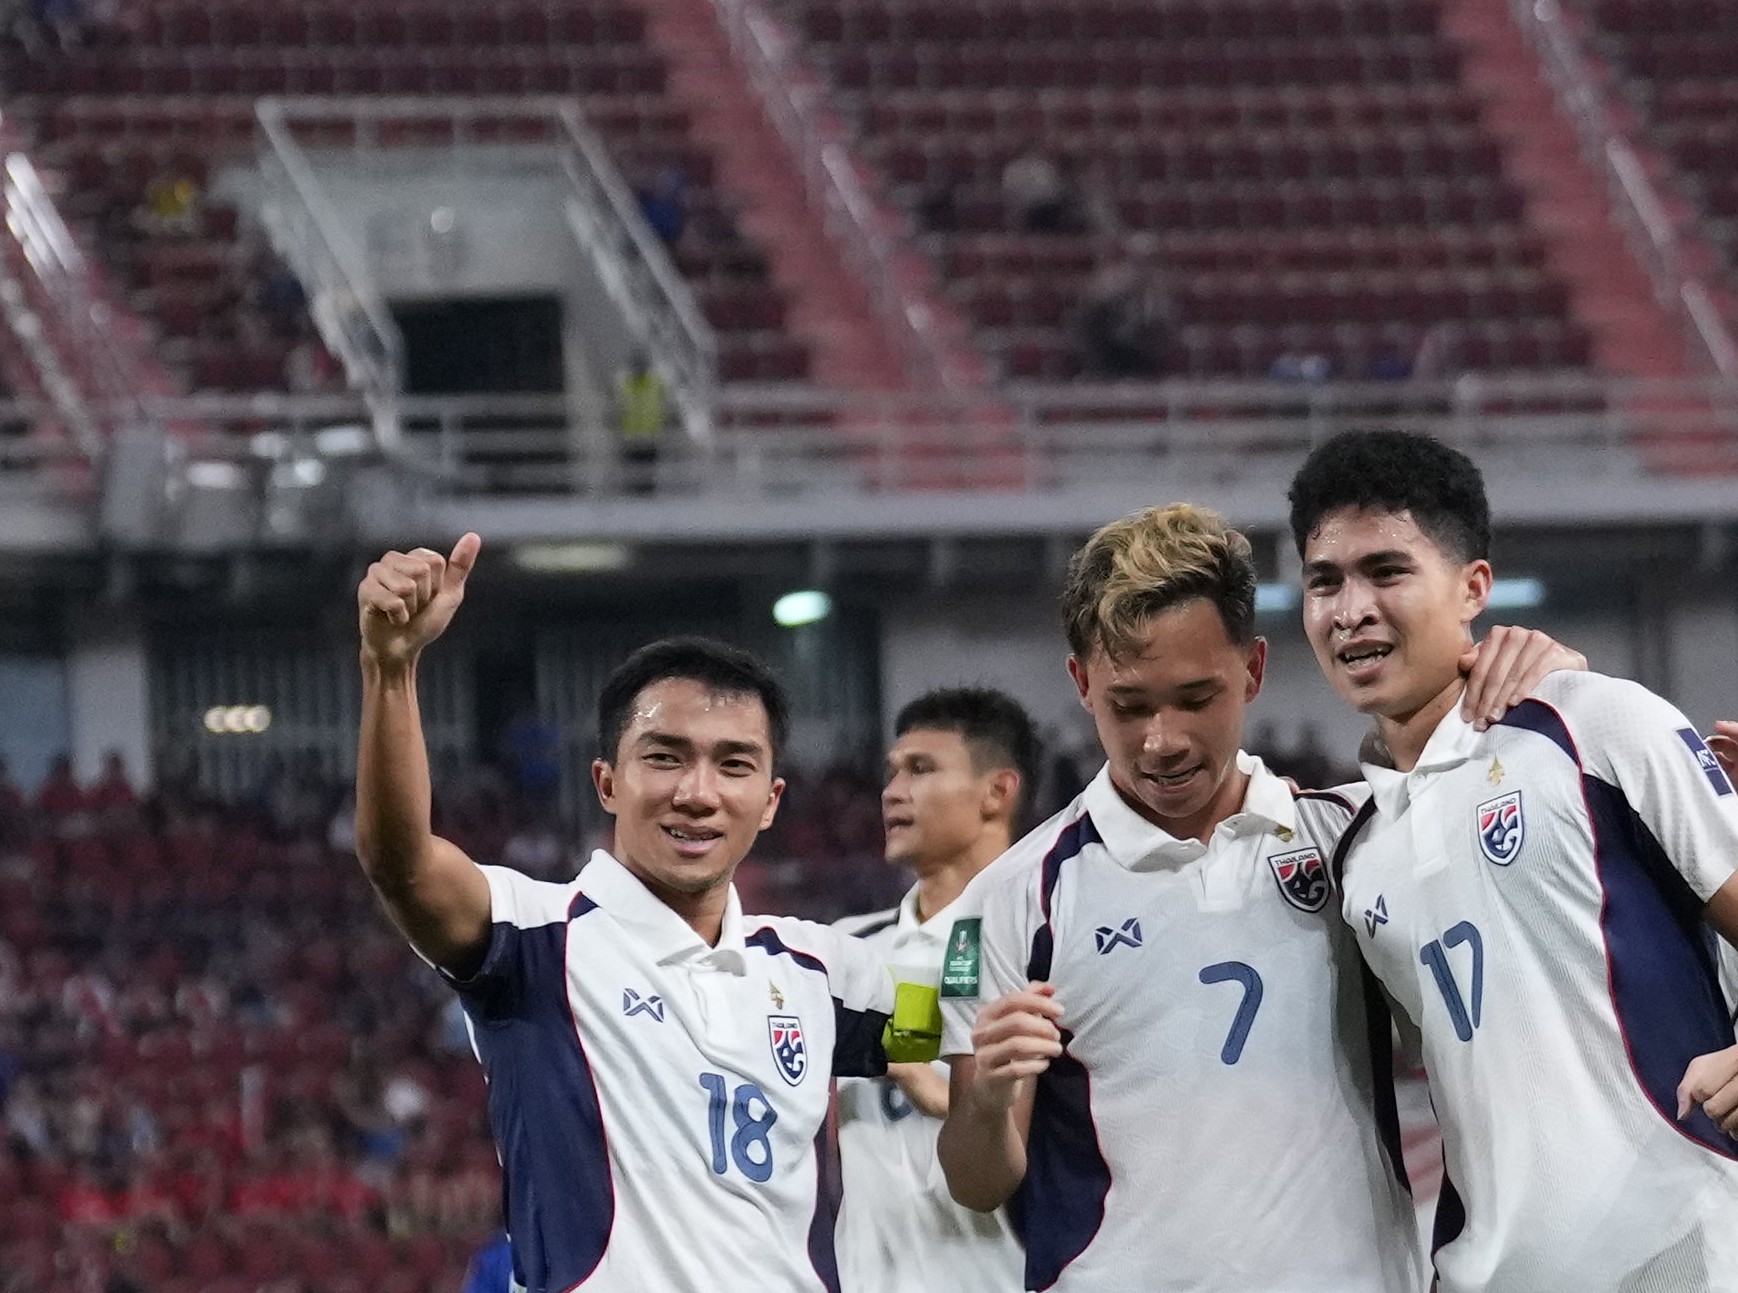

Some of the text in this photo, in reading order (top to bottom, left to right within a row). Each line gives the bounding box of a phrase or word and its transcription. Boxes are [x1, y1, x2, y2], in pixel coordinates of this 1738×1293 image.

[1199, 961, 1264, 1066] 7
[1420, 920, 1484, 1042] 17
[699, 1072, 778, 1183] 18
